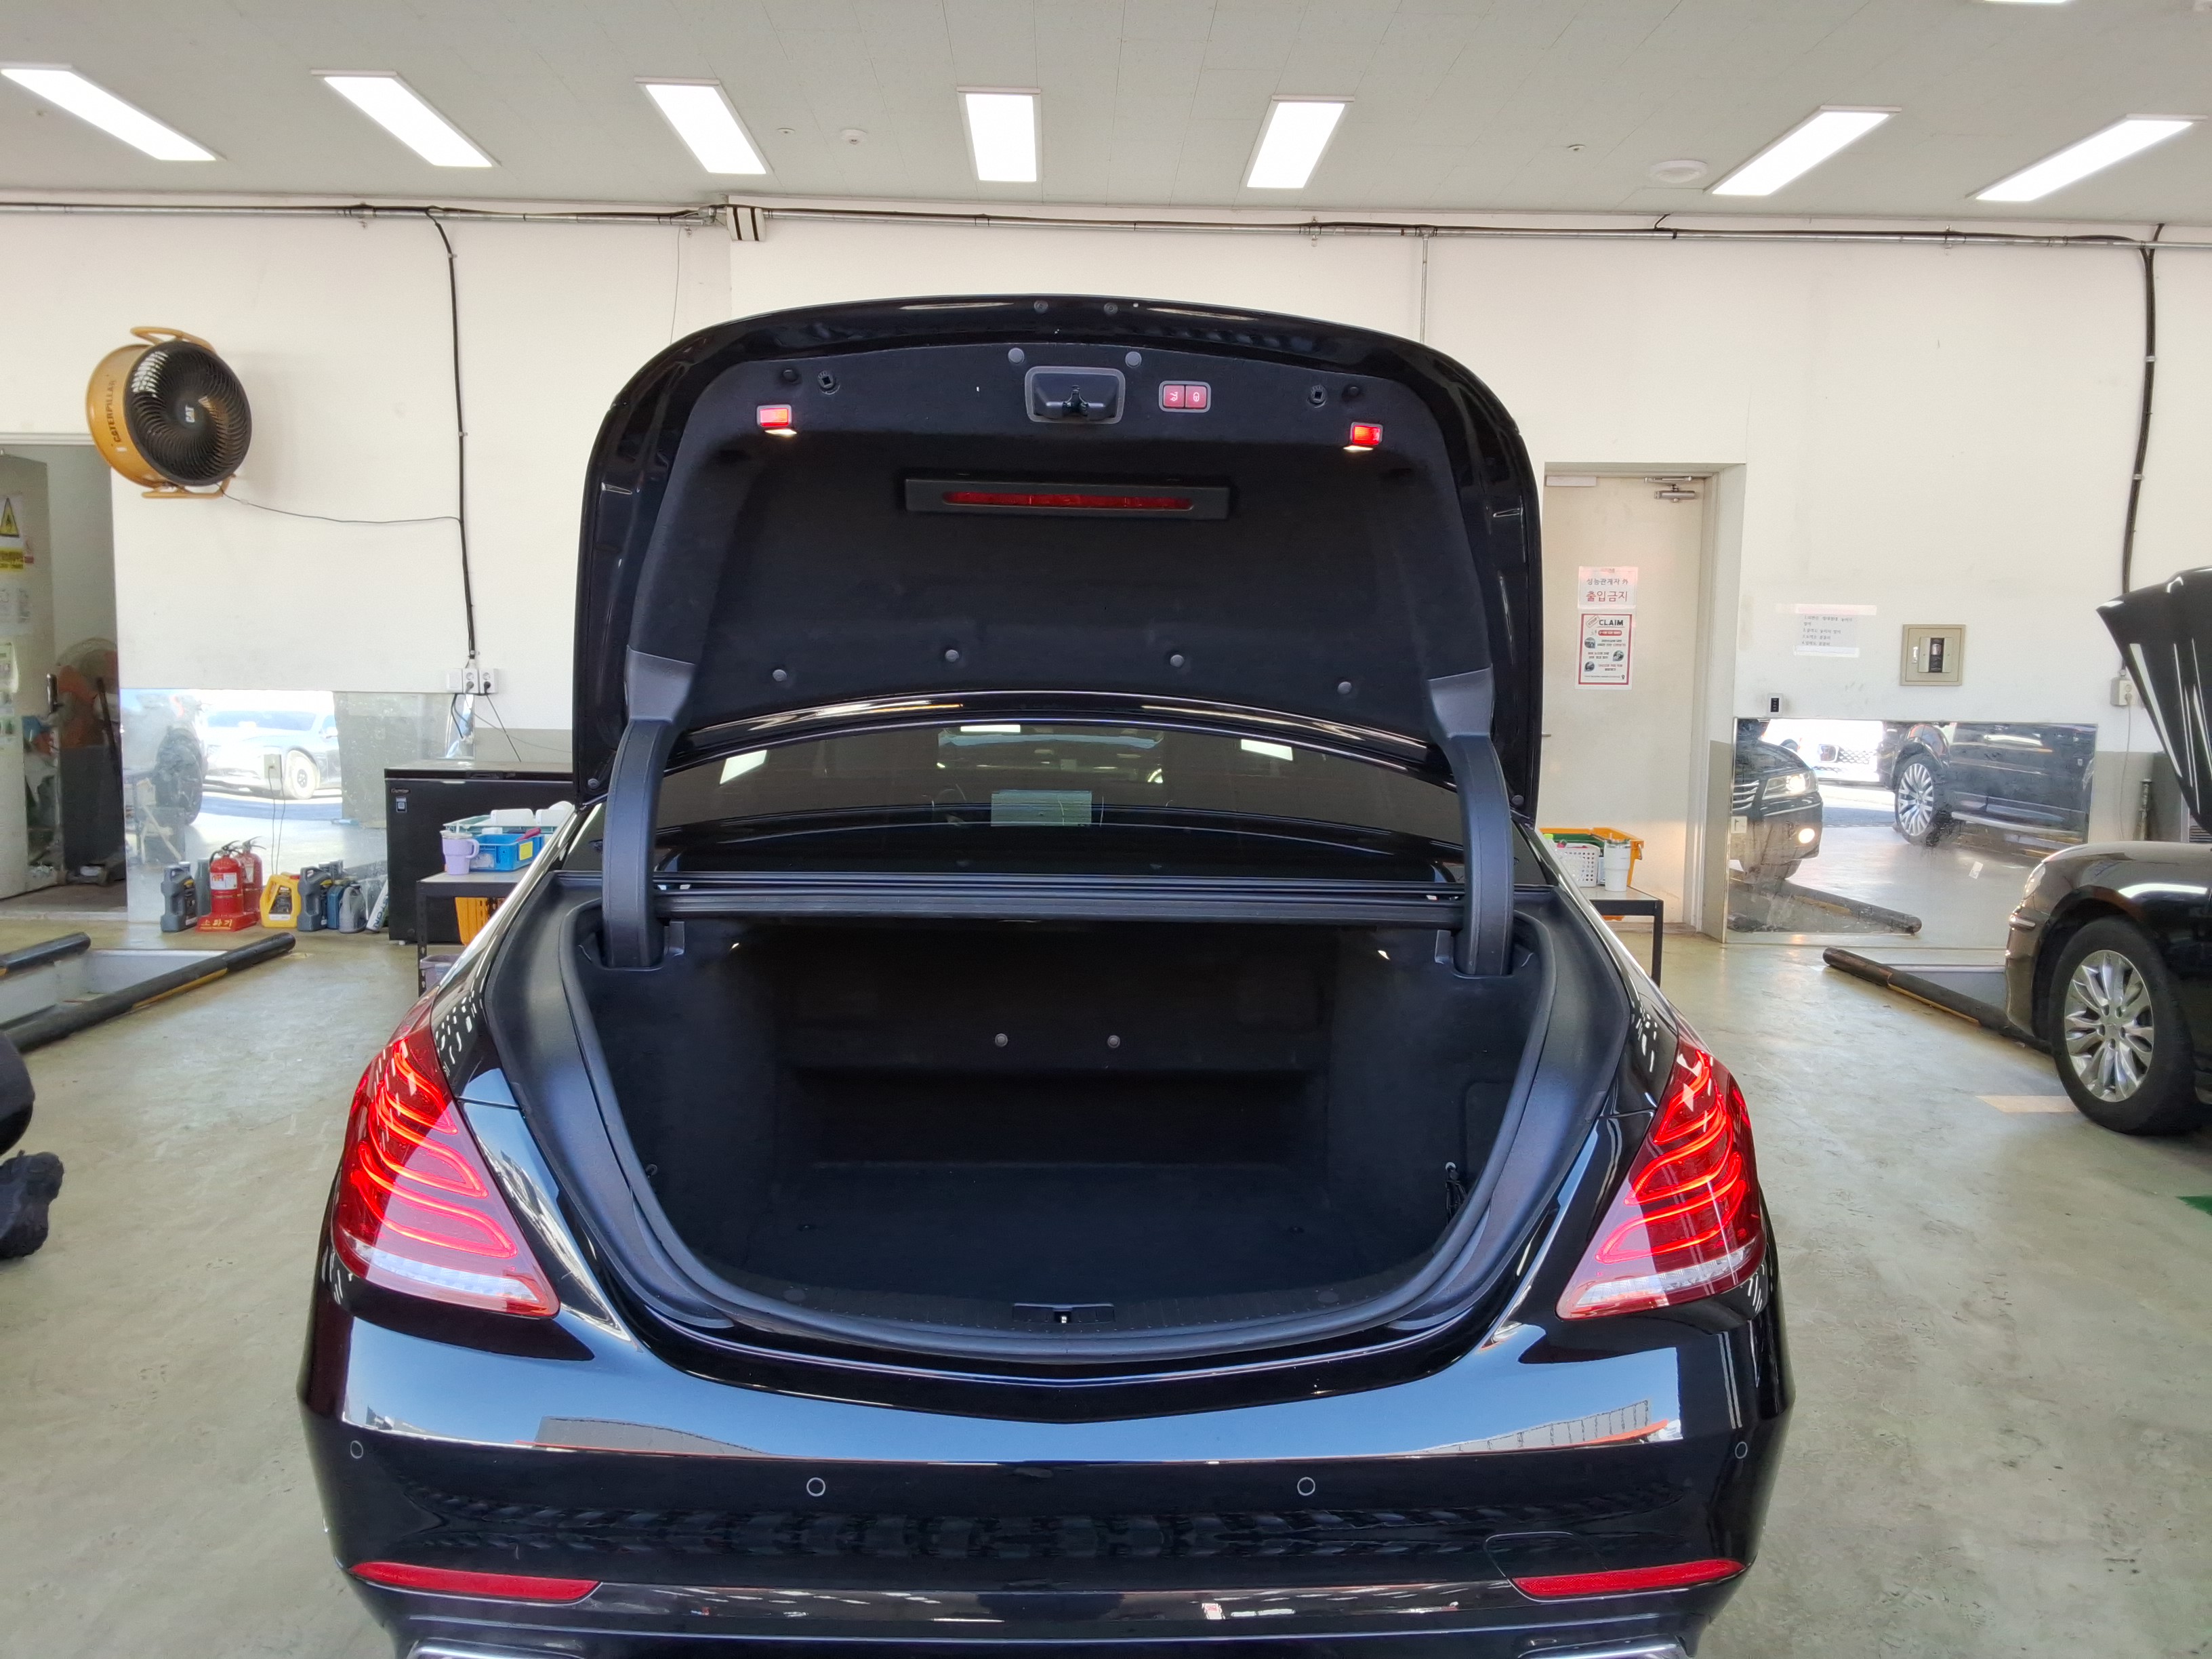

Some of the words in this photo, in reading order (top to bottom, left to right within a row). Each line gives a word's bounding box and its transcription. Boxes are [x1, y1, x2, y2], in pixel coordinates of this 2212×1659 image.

[106, 380, 121, 443] CATERPILLAR
[185, 405, 194, 423] CAT
[1586, 590, 1628, 602] 출입금지
[201, 918, 233, 927] 소화기
